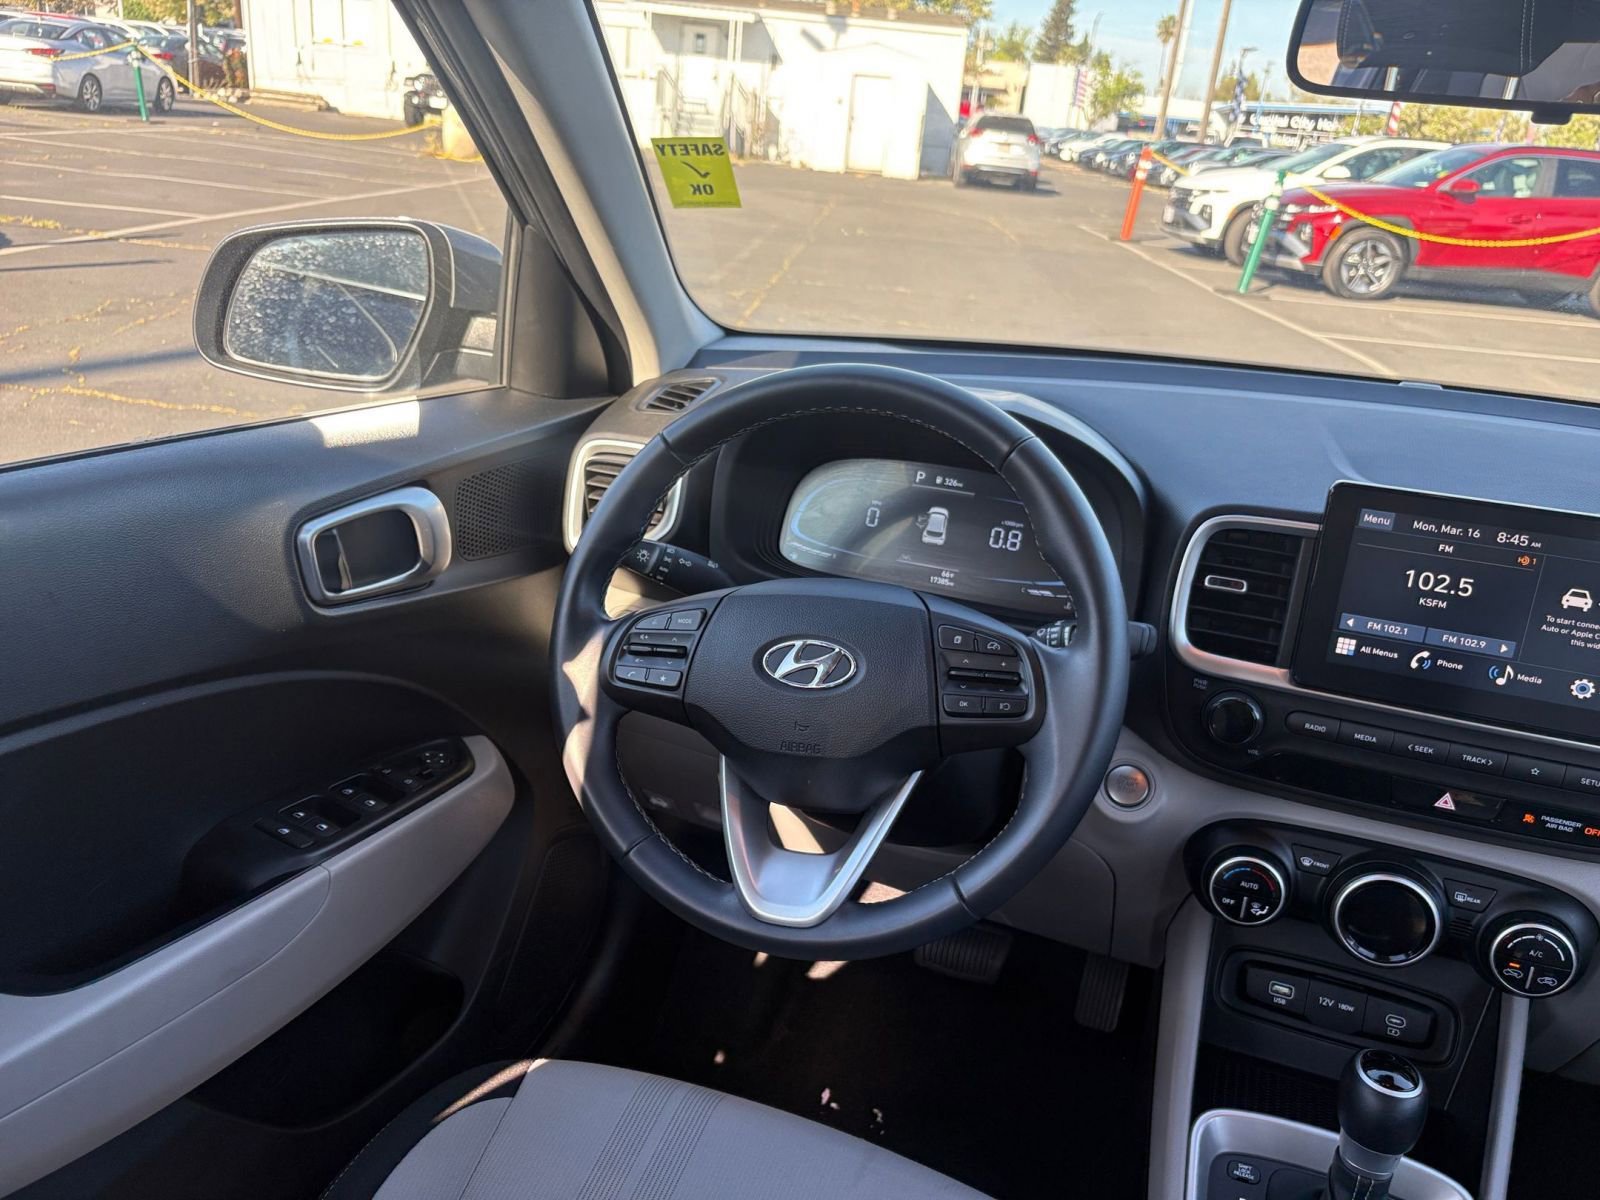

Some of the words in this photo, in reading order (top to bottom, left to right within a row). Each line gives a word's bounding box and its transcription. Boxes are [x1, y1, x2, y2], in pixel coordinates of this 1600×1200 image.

[1290, 115, 1315, 131] City
[916, 471, 926, 483] P
[865, 507, 880, 527] 0
[1363, 514, 1391, 525] Menu
[1440, 524, 1463, 536] Mar.
[1467, 528, 1480, 538] 16
[989, 527, 1022, 551] 0.8
[1496, 532, 1529, 546] 8:45
[1438, 544, 1454, 553] FM
[1406, 569, 1474, 597] 102.5
[1418, 597, 1447, 609] KSFM
[1556, 618, 1575, 626] start
[1367, 621, 1381, 631] FM
[1383, 624, 1408, 635] 102.1
[1541, 624, 1559, 632] Auto
[1570, 629, 1593, 639] Apple
[1442, 634, 1457, 644] FM
[1460, 637, 1487, 649] 102.9
[1570, 639, 1585, 647] this
[1360, 646, 1371, 654] All
[1372, 648, 1399, 659] Menus
[1436, 659, 1463, 670] Phone
[1516, 673, 1542, 684] Media
[1304, 723, 1327, 733] RADIO
[1353, 733, 1377, 743] MEDIA
[780, 741, 821, 754] AIRBAG
[1414, 745, 1434, 754] SEEK
[1462, 754, 1487, 765] TRACK
[1541, 815, 1582, 828] PASSENGER
[1558, 825, 1573, 833] BAG
[1313, 861, 1330, 869] FRONT
[1240, 881, 1259, 890] AUTO
[1222, 897, 1235, 905] OFF
[1466, 896, 1480, 904] REAR
[1529, 950, 1543, 958] A/C
[1273, 997, 1286, 1005] USB
[1318, 996, 1335, 1007] 12V
